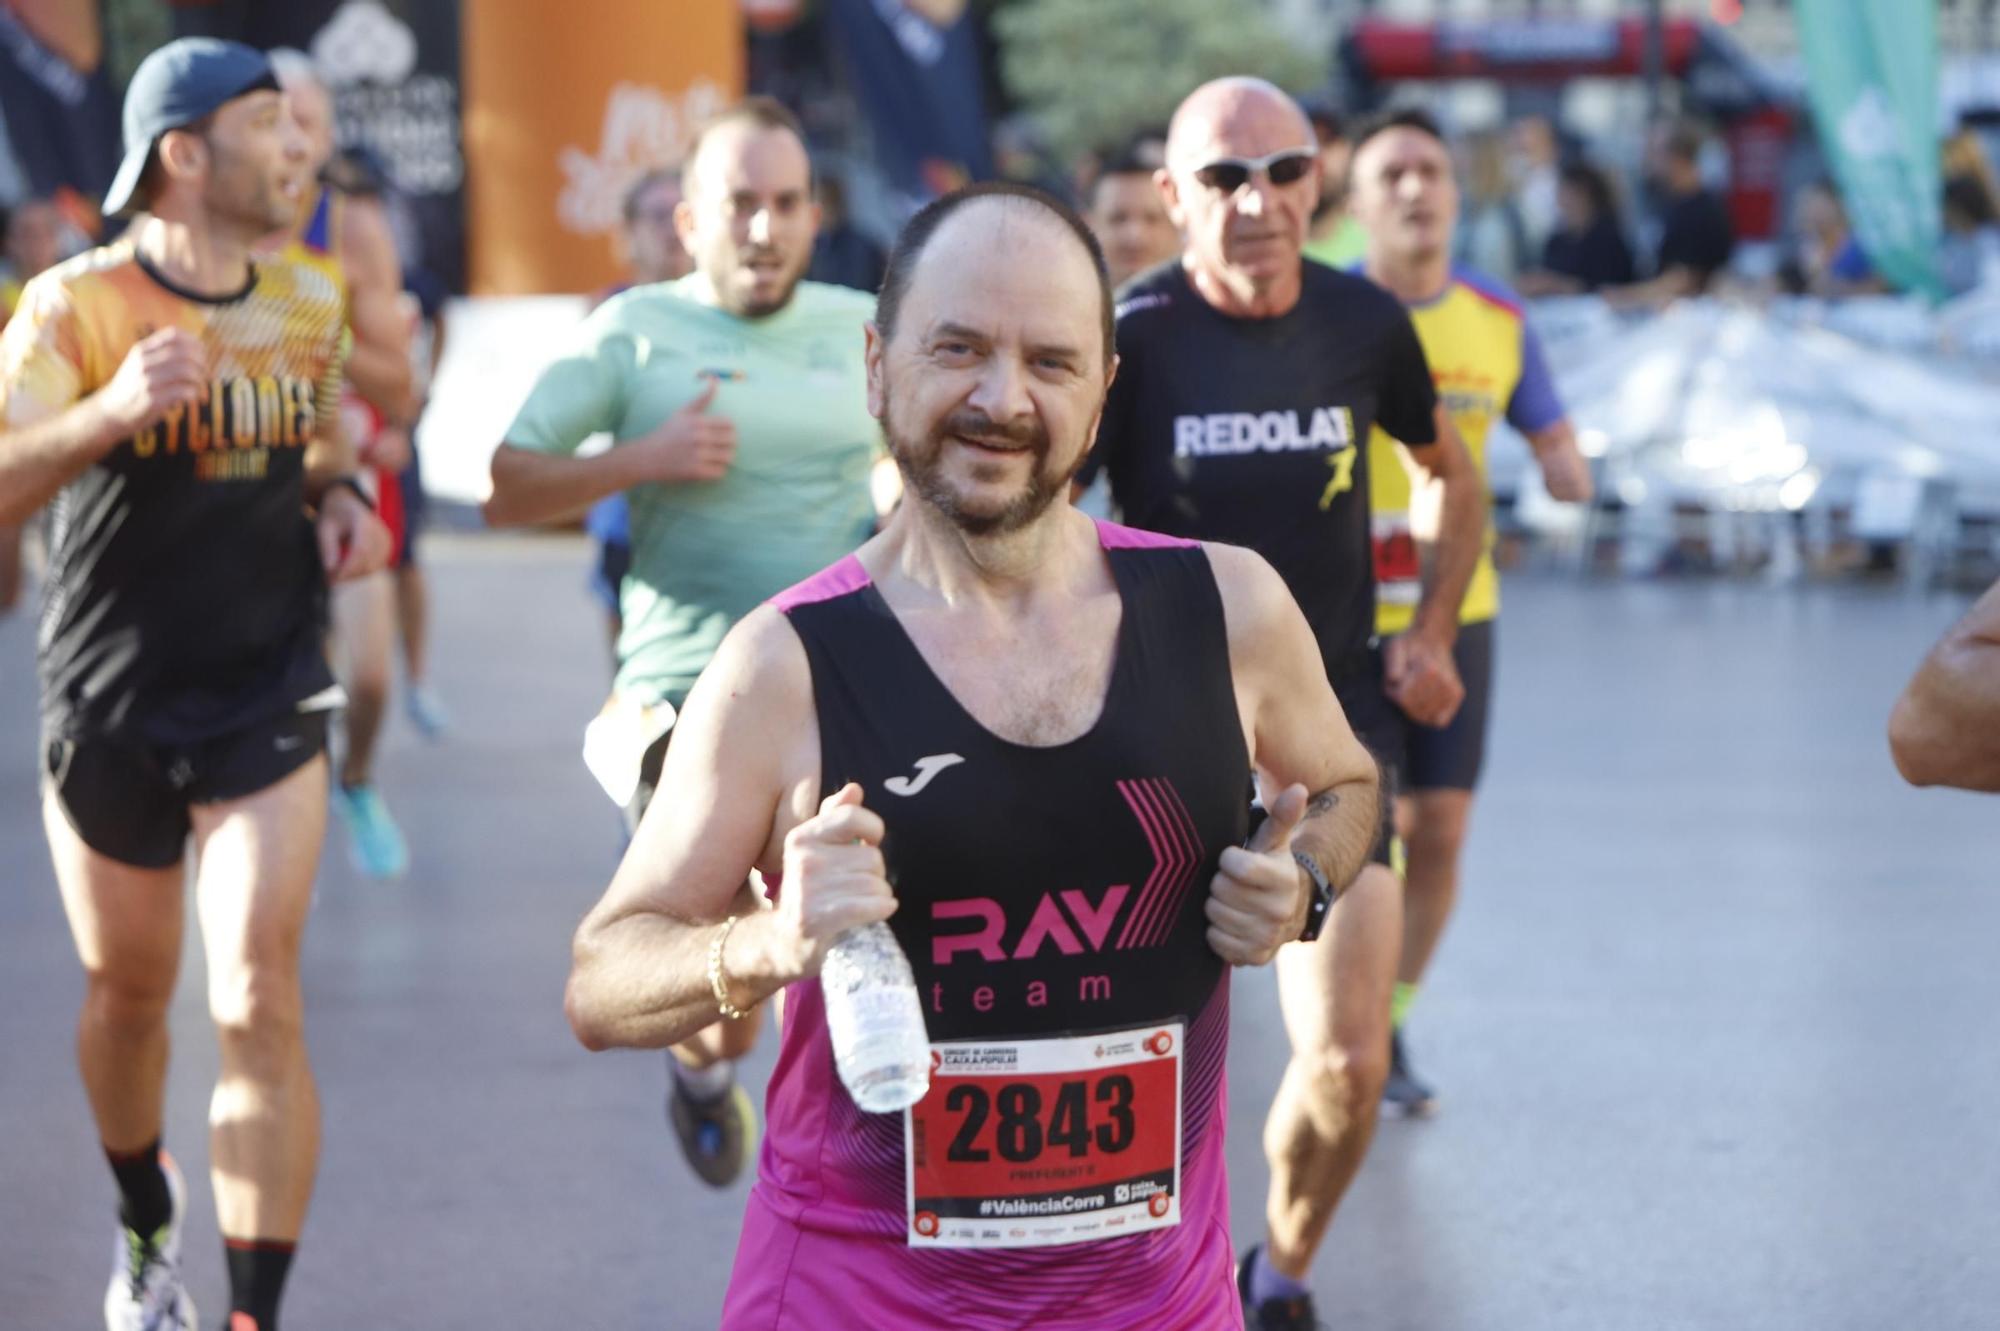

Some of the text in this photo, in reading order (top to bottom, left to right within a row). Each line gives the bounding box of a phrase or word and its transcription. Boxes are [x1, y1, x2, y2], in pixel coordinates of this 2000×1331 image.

[931, 884, 1130, 965] RAV
[932, 974, 1111, 1012] team
[945, 1074, 1135, 1163] 2843
[980, 1194, 1105, 1215] #ValènciaCorre
